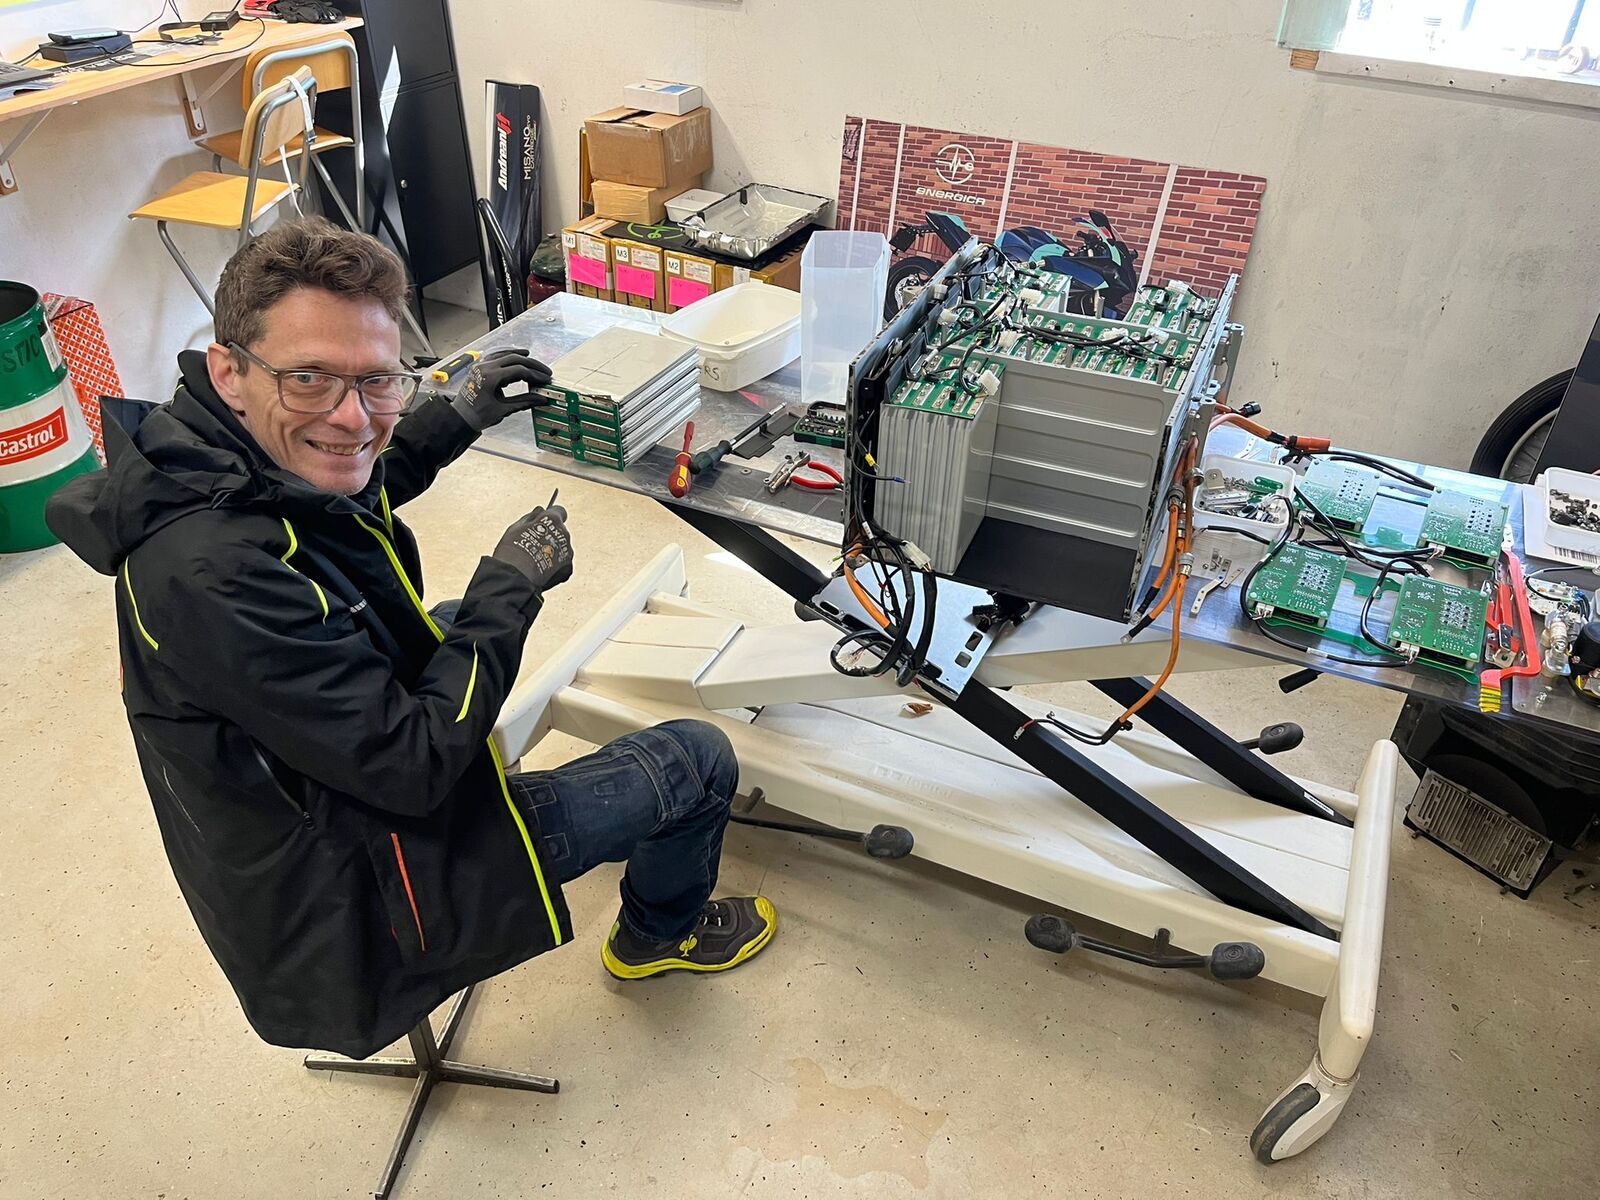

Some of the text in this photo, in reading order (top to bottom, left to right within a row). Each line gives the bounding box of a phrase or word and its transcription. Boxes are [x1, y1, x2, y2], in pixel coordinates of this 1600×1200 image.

[523, 126, 532, 180] MISANO
[668, 260, 679, 270] M2
[0, 332, 39, 375] STIC
[0, 424, 56, 457] Castrol
